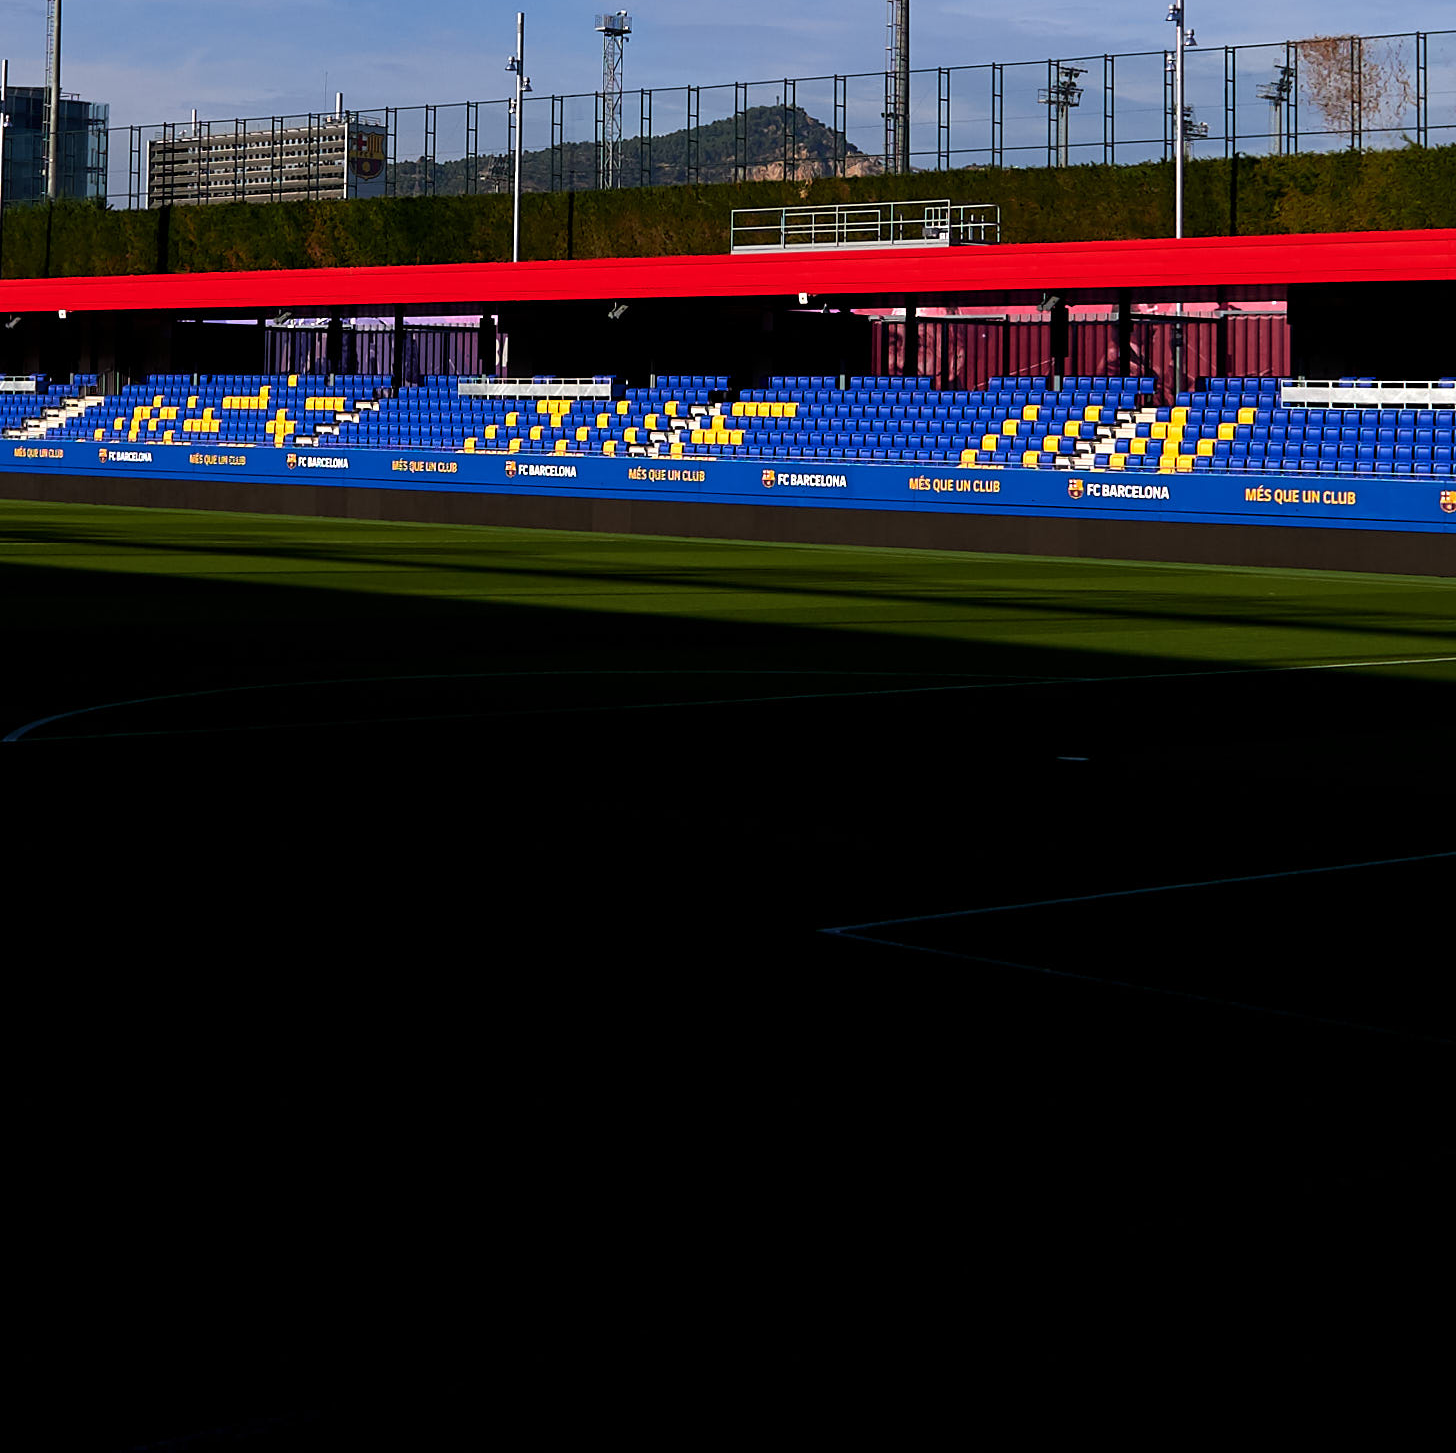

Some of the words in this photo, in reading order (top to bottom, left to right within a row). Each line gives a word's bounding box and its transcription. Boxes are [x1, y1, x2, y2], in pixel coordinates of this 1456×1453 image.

[108, 451, 116, 462] FC
[298, 457, 306, 467] FC
[307, 457, 348, 469] BARCELONA
[392, 458, 408, 471] MÉS
[409, 460, 424, 473] QUE
[425, 461, 437, 472] UN
[437, 461, 457, 473] CLUB
[518, 464, 528, 476] FC
[529, 464, 577, 477] BARCELONA
[628, 466, 646, 480] MÉS
[648, 469, 666, 483] QUE
[668, 469, 680, 481] UN
[682, 470, 705, 482] CLUB
[778, 473, 790, 486] FC
[791, 473, 847, 488] BARCELONA
[909, 475, 930, 490] MÉS
[932, 478, 953, 492] QUE
[956, 479, 971, 492] UN
[973, 479, 1000, 493] CLUB
[1087, 483, 1101, 497] FC
[1102, 484, 1169, 500] BARCELONA
[1245, 484, 1272, 502] MÉS
[1274, 488, 1299, 505] QUE
[1302, 490, 1320, 503] UN
[1323, 490, 1356, 506] CLUB
